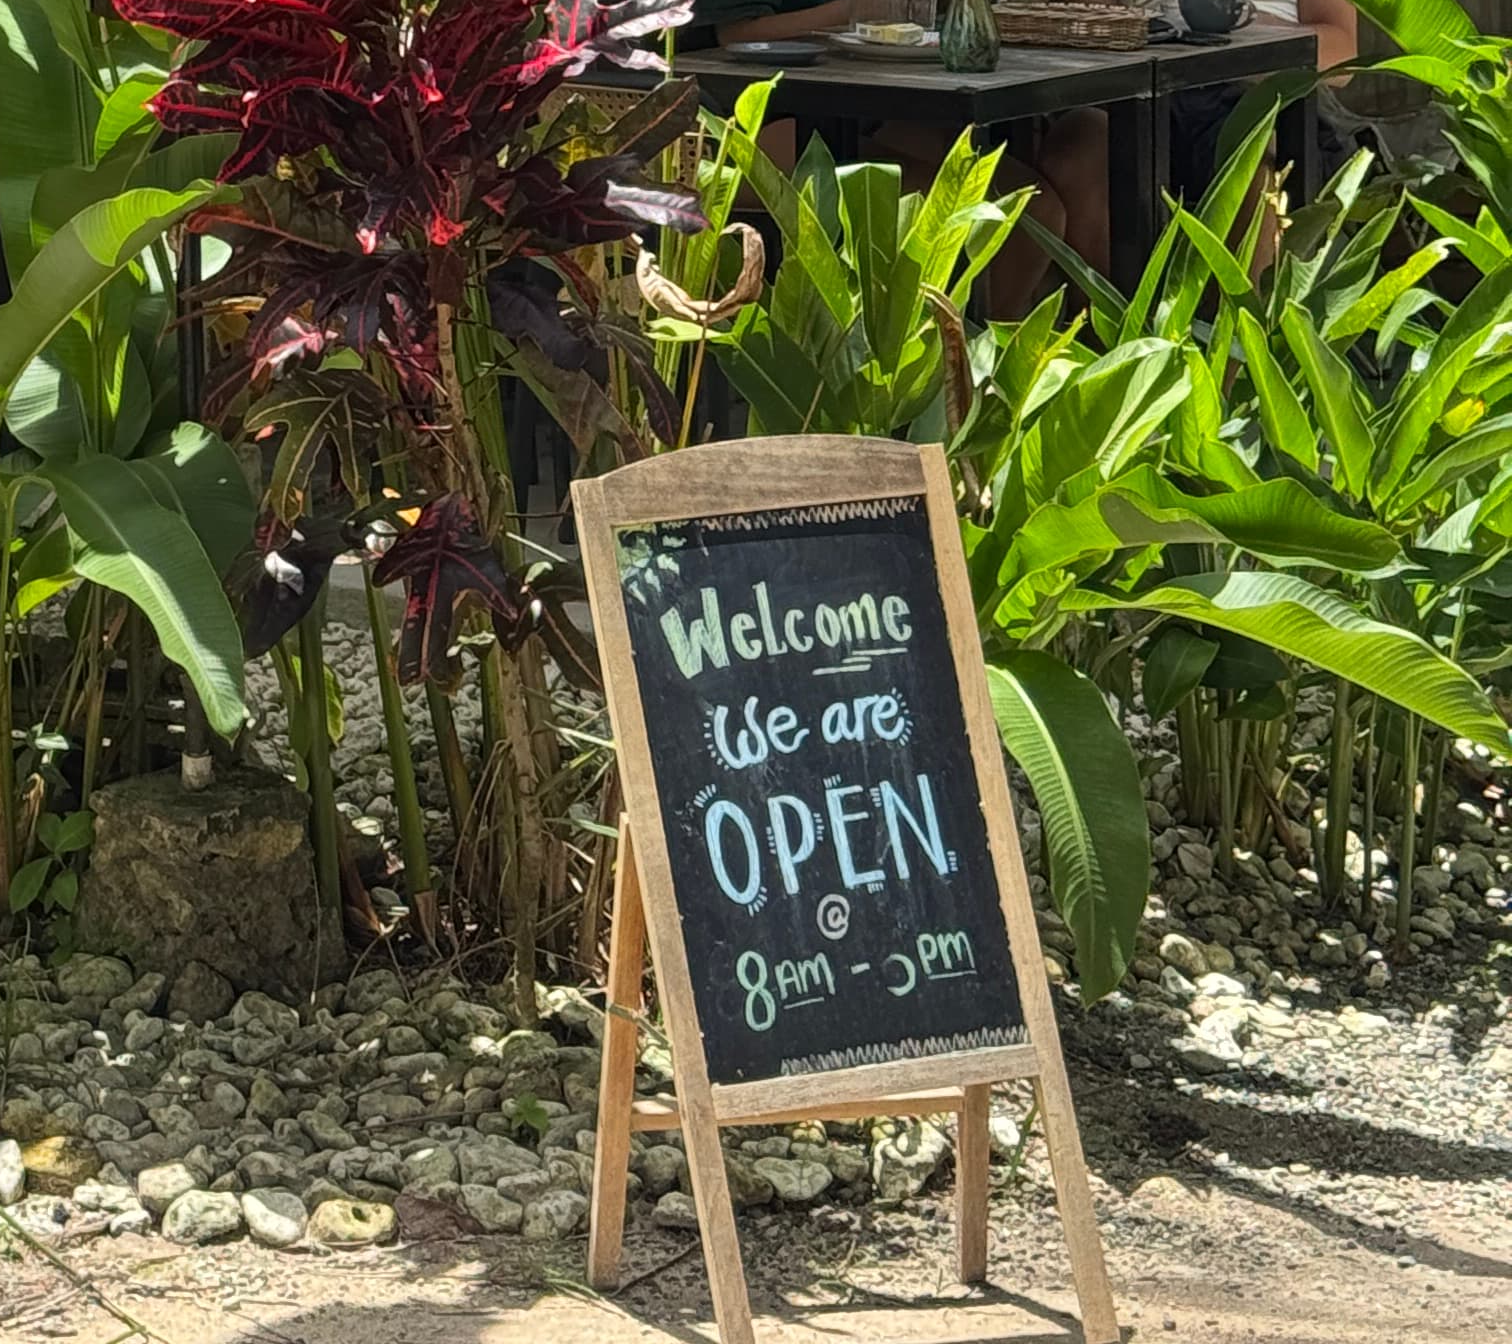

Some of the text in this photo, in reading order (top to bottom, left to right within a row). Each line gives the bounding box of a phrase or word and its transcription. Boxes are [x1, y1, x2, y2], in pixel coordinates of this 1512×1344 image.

[661, 581, 913, 679] Welcome
[713, 693, 907, 771] We are
[705, 773, 951, 906] OPEN
[816, 894, 852, 940] @
